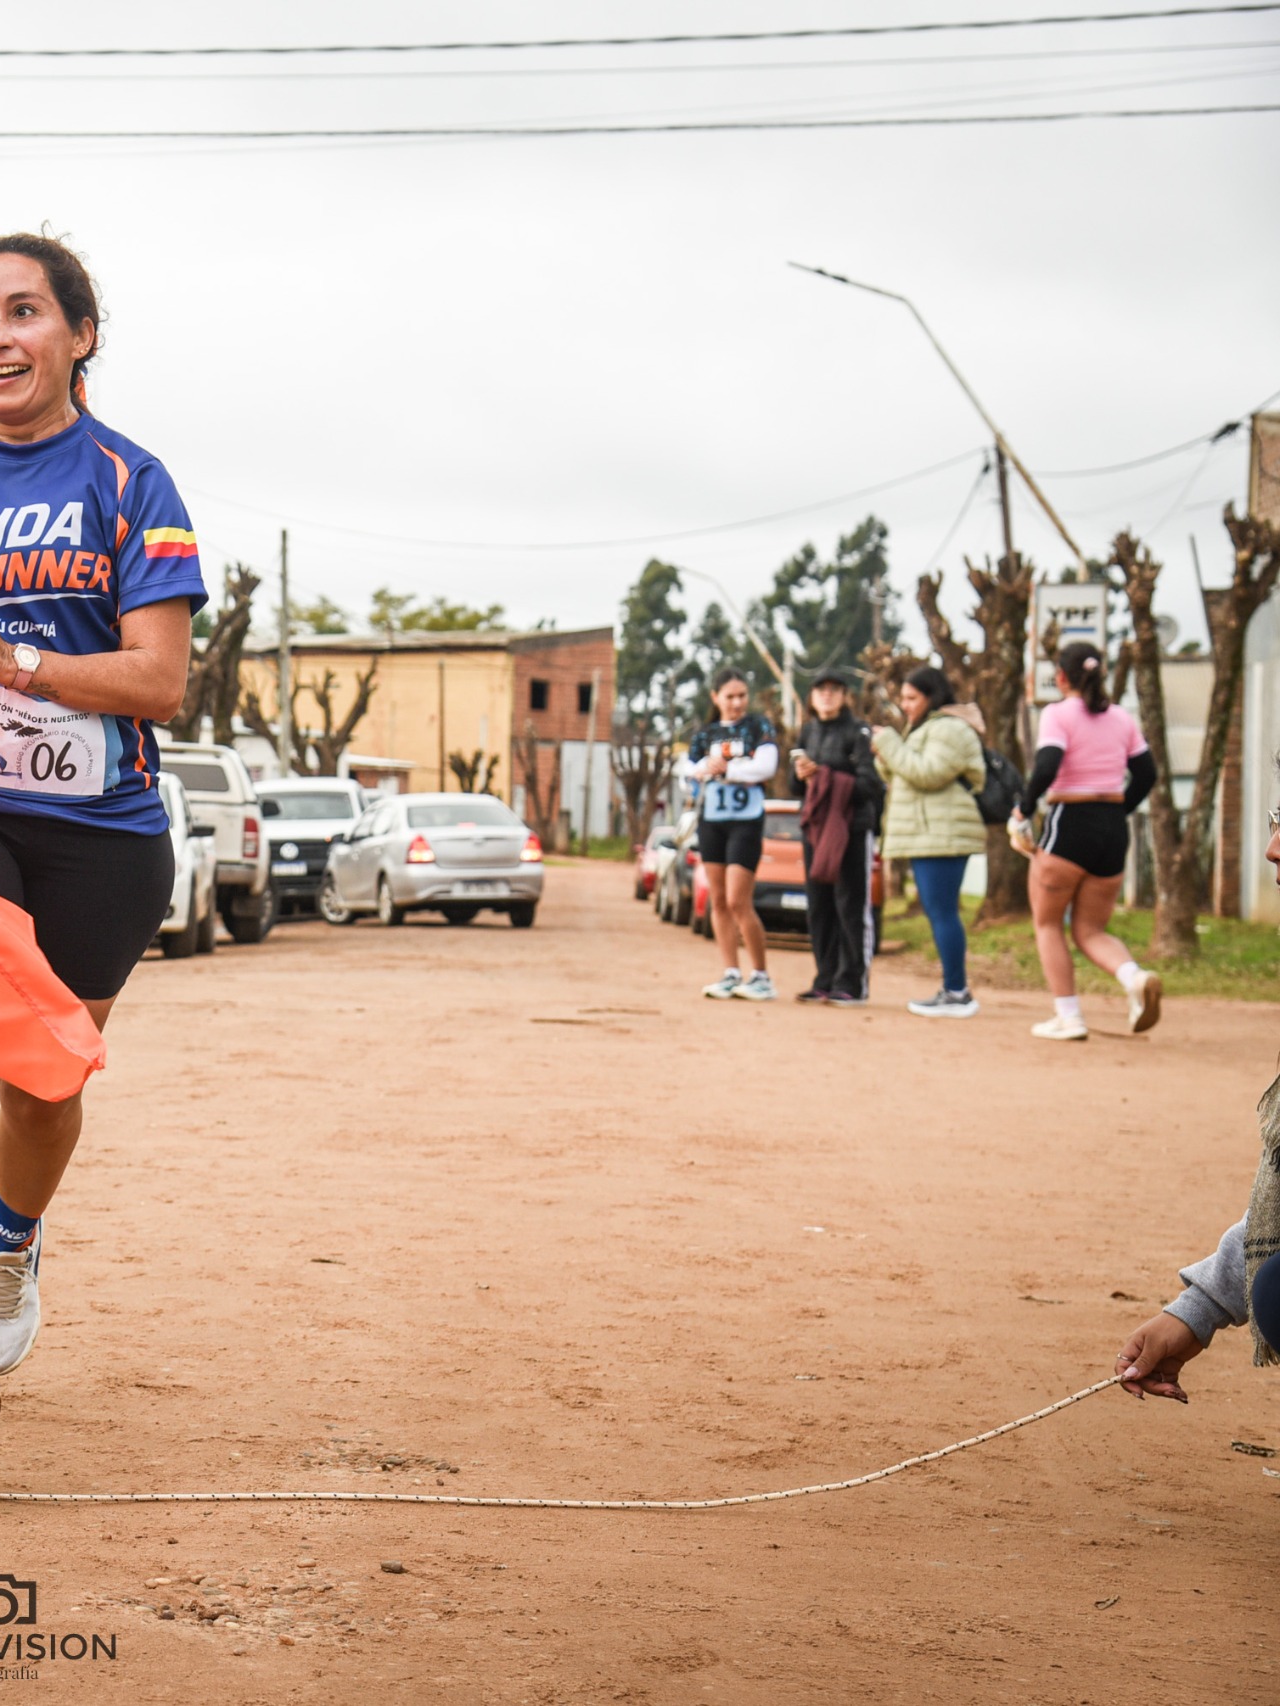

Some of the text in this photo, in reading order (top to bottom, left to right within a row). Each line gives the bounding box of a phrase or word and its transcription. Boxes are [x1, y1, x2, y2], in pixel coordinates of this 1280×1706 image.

[1048, 605, 1098, 621] YPF
[30, 740, 78, 782] 06
[716, 786, 750, 812] 19
